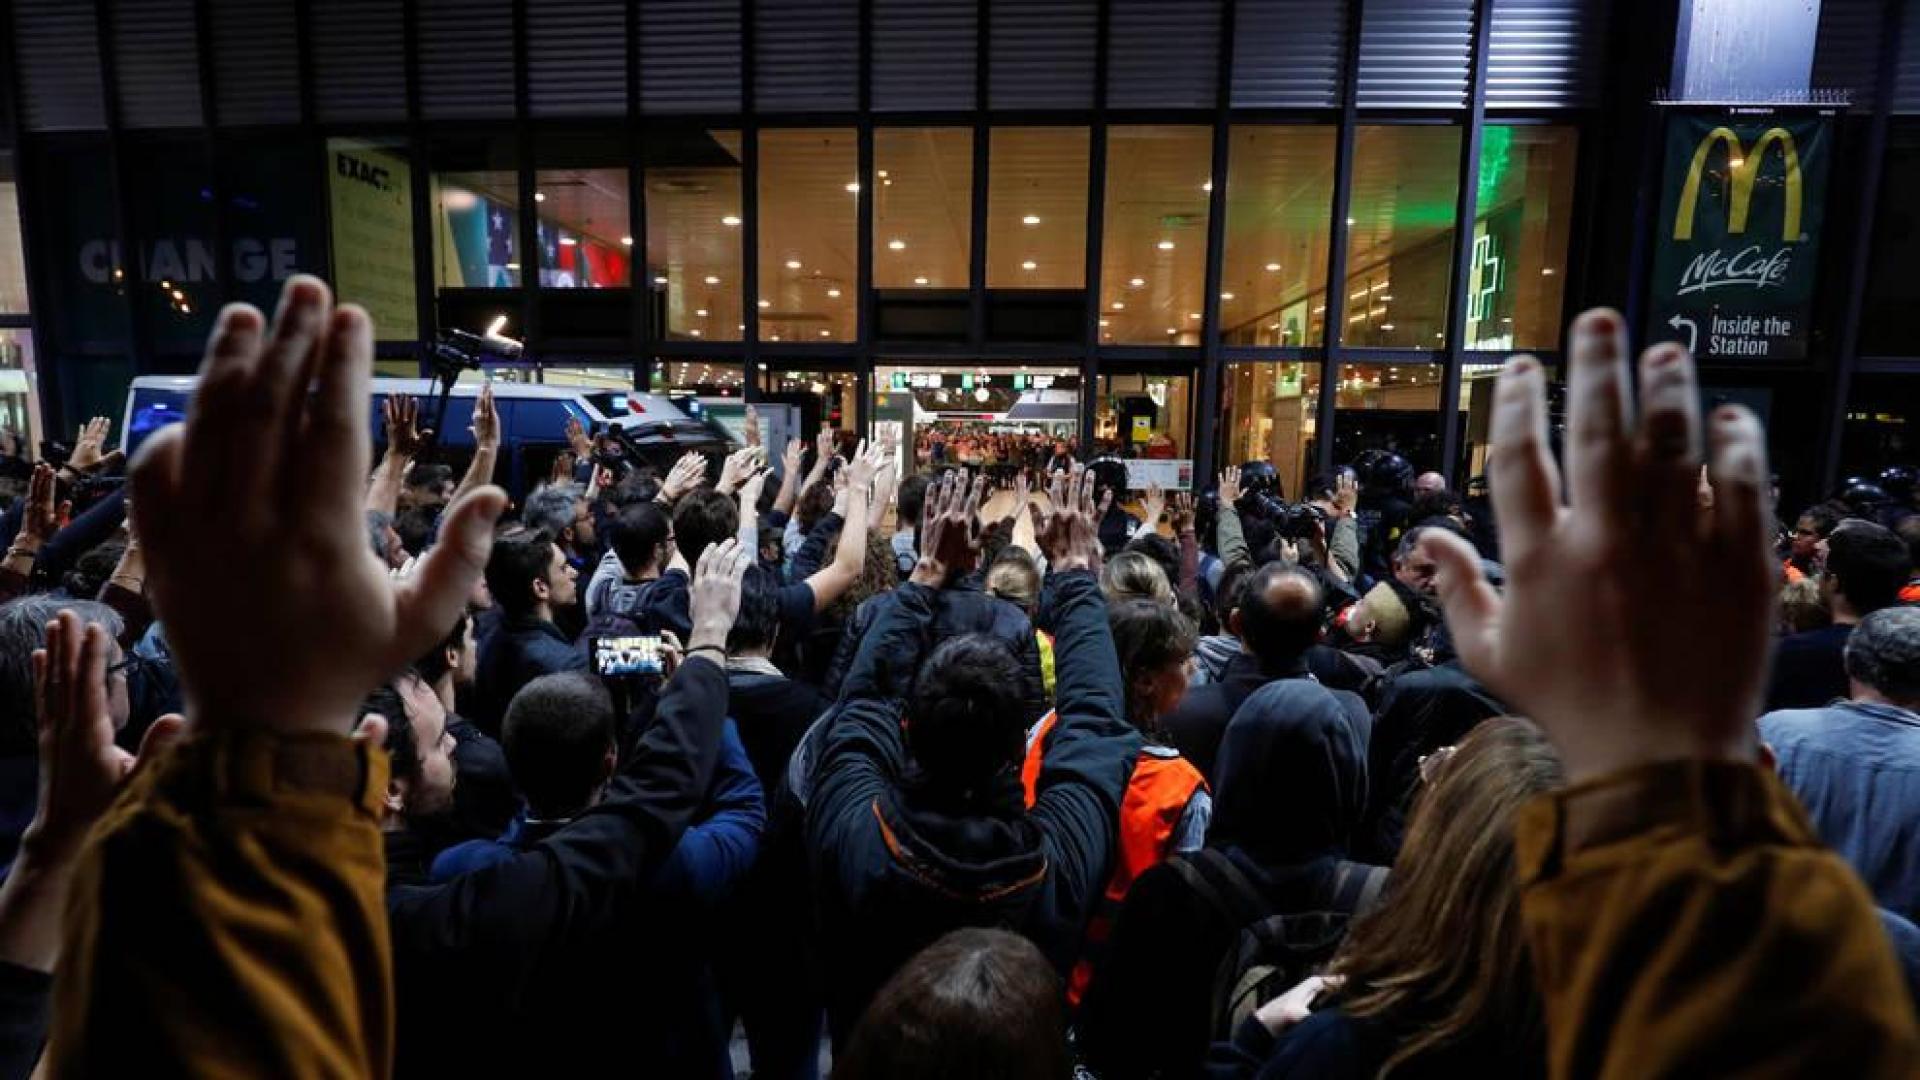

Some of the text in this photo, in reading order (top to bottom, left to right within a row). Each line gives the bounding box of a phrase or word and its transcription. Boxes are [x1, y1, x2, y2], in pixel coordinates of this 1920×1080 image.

[1710, 315, 1792, 337] Inside the
[1708, 336, 1768, 358] Station
